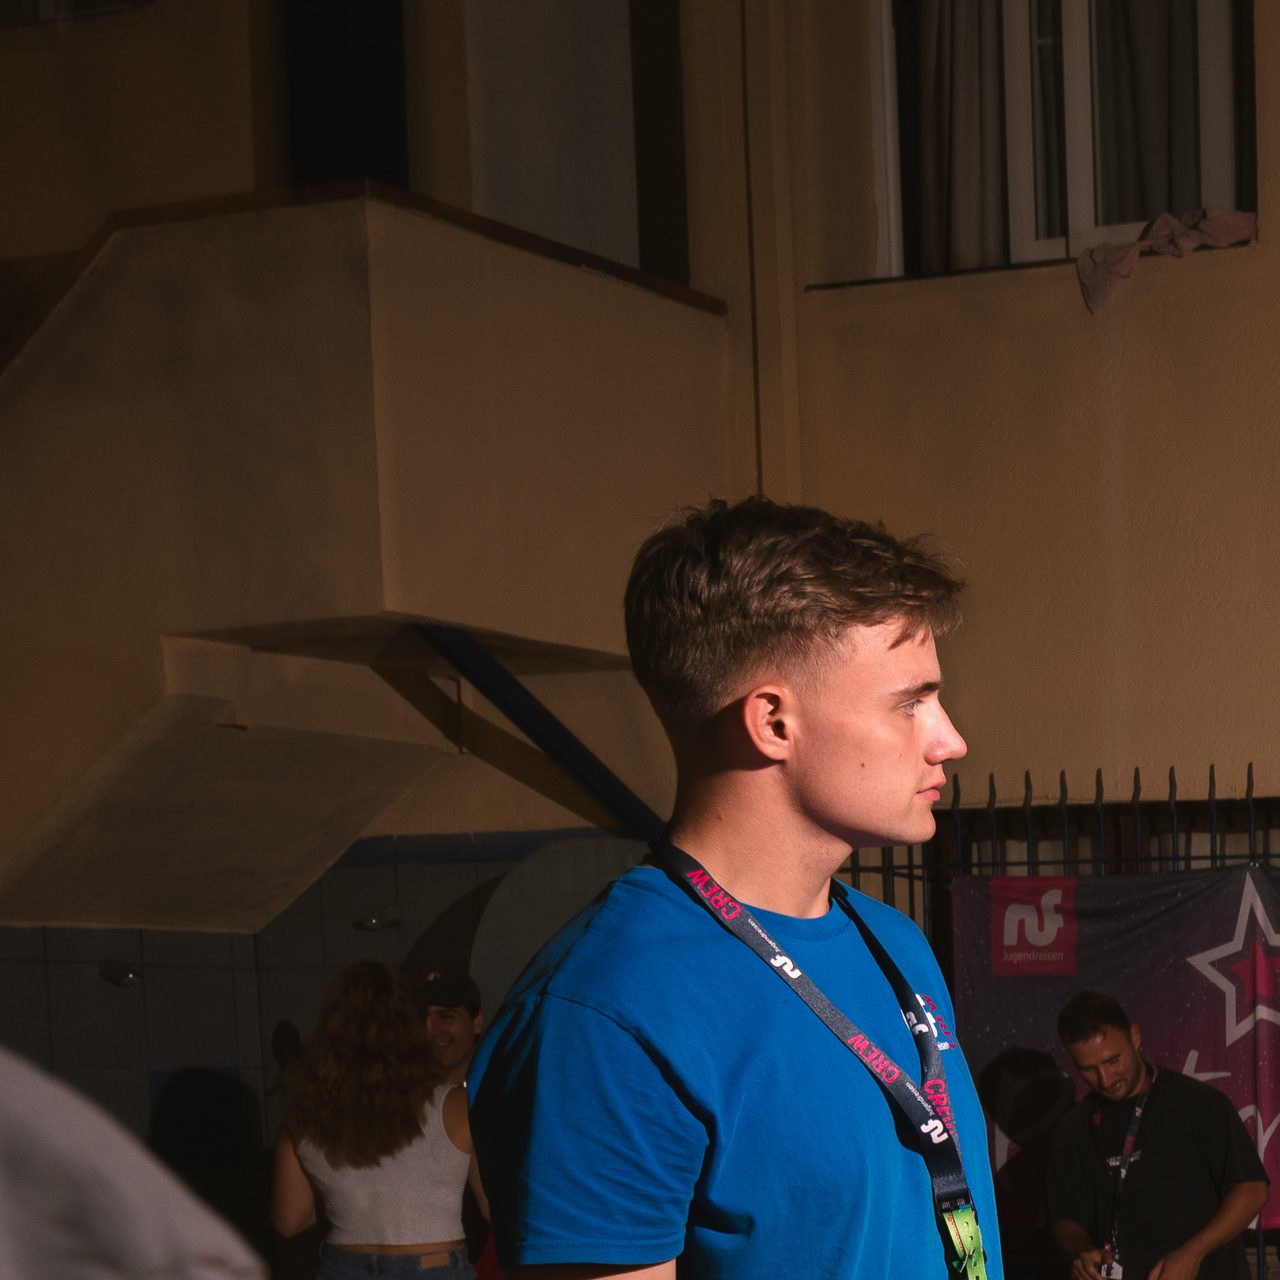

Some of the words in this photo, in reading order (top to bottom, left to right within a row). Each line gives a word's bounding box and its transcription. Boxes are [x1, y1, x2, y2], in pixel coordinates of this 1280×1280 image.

[687, 869, 742, 920] CREW
[1002, 949, 1064, 964] Jugendreisen
[847, 1033, 901, 1083] CREW
